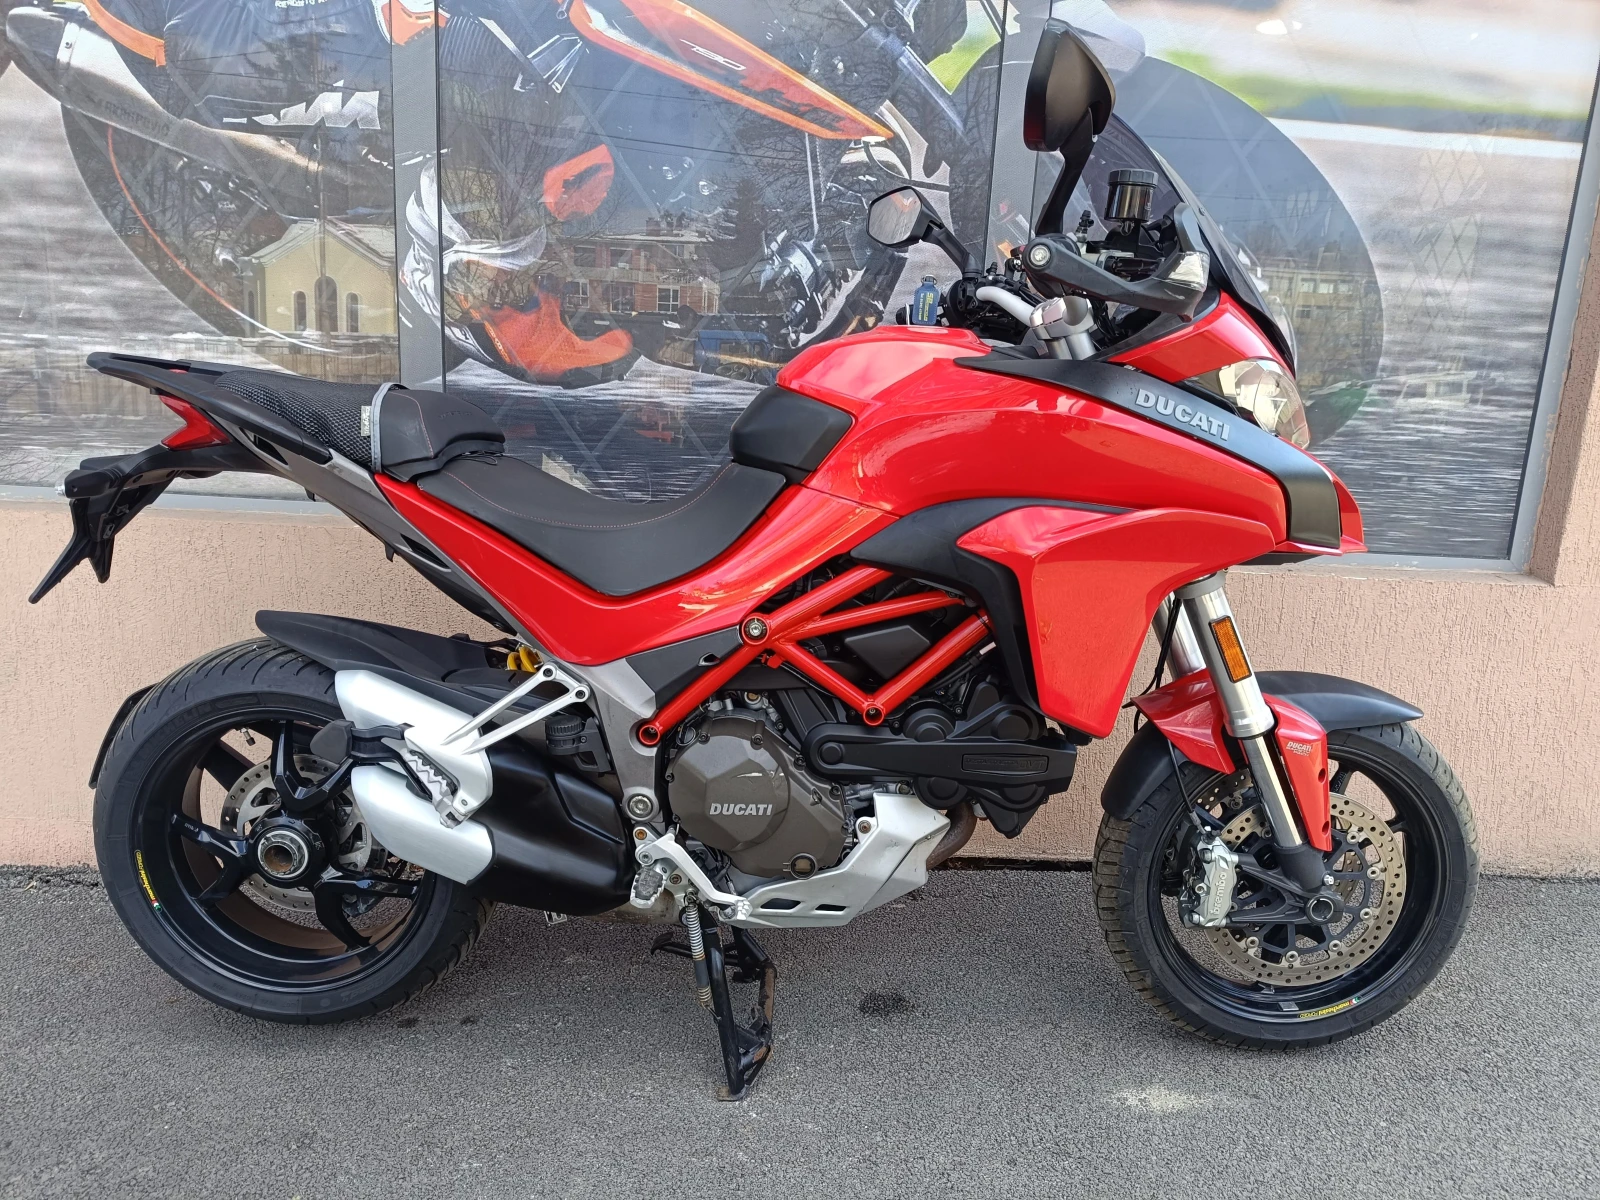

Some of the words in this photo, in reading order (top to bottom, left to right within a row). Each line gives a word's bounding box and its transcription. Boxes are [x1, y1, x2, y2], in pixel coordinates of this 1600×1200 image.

[1135, 388, 1230, 441] DUCATI
[1287, 741, 1312, 751] DUCATI
[709, 802, 773, 816] DUCATI
[1210, 871, 1228, 915] brembo
